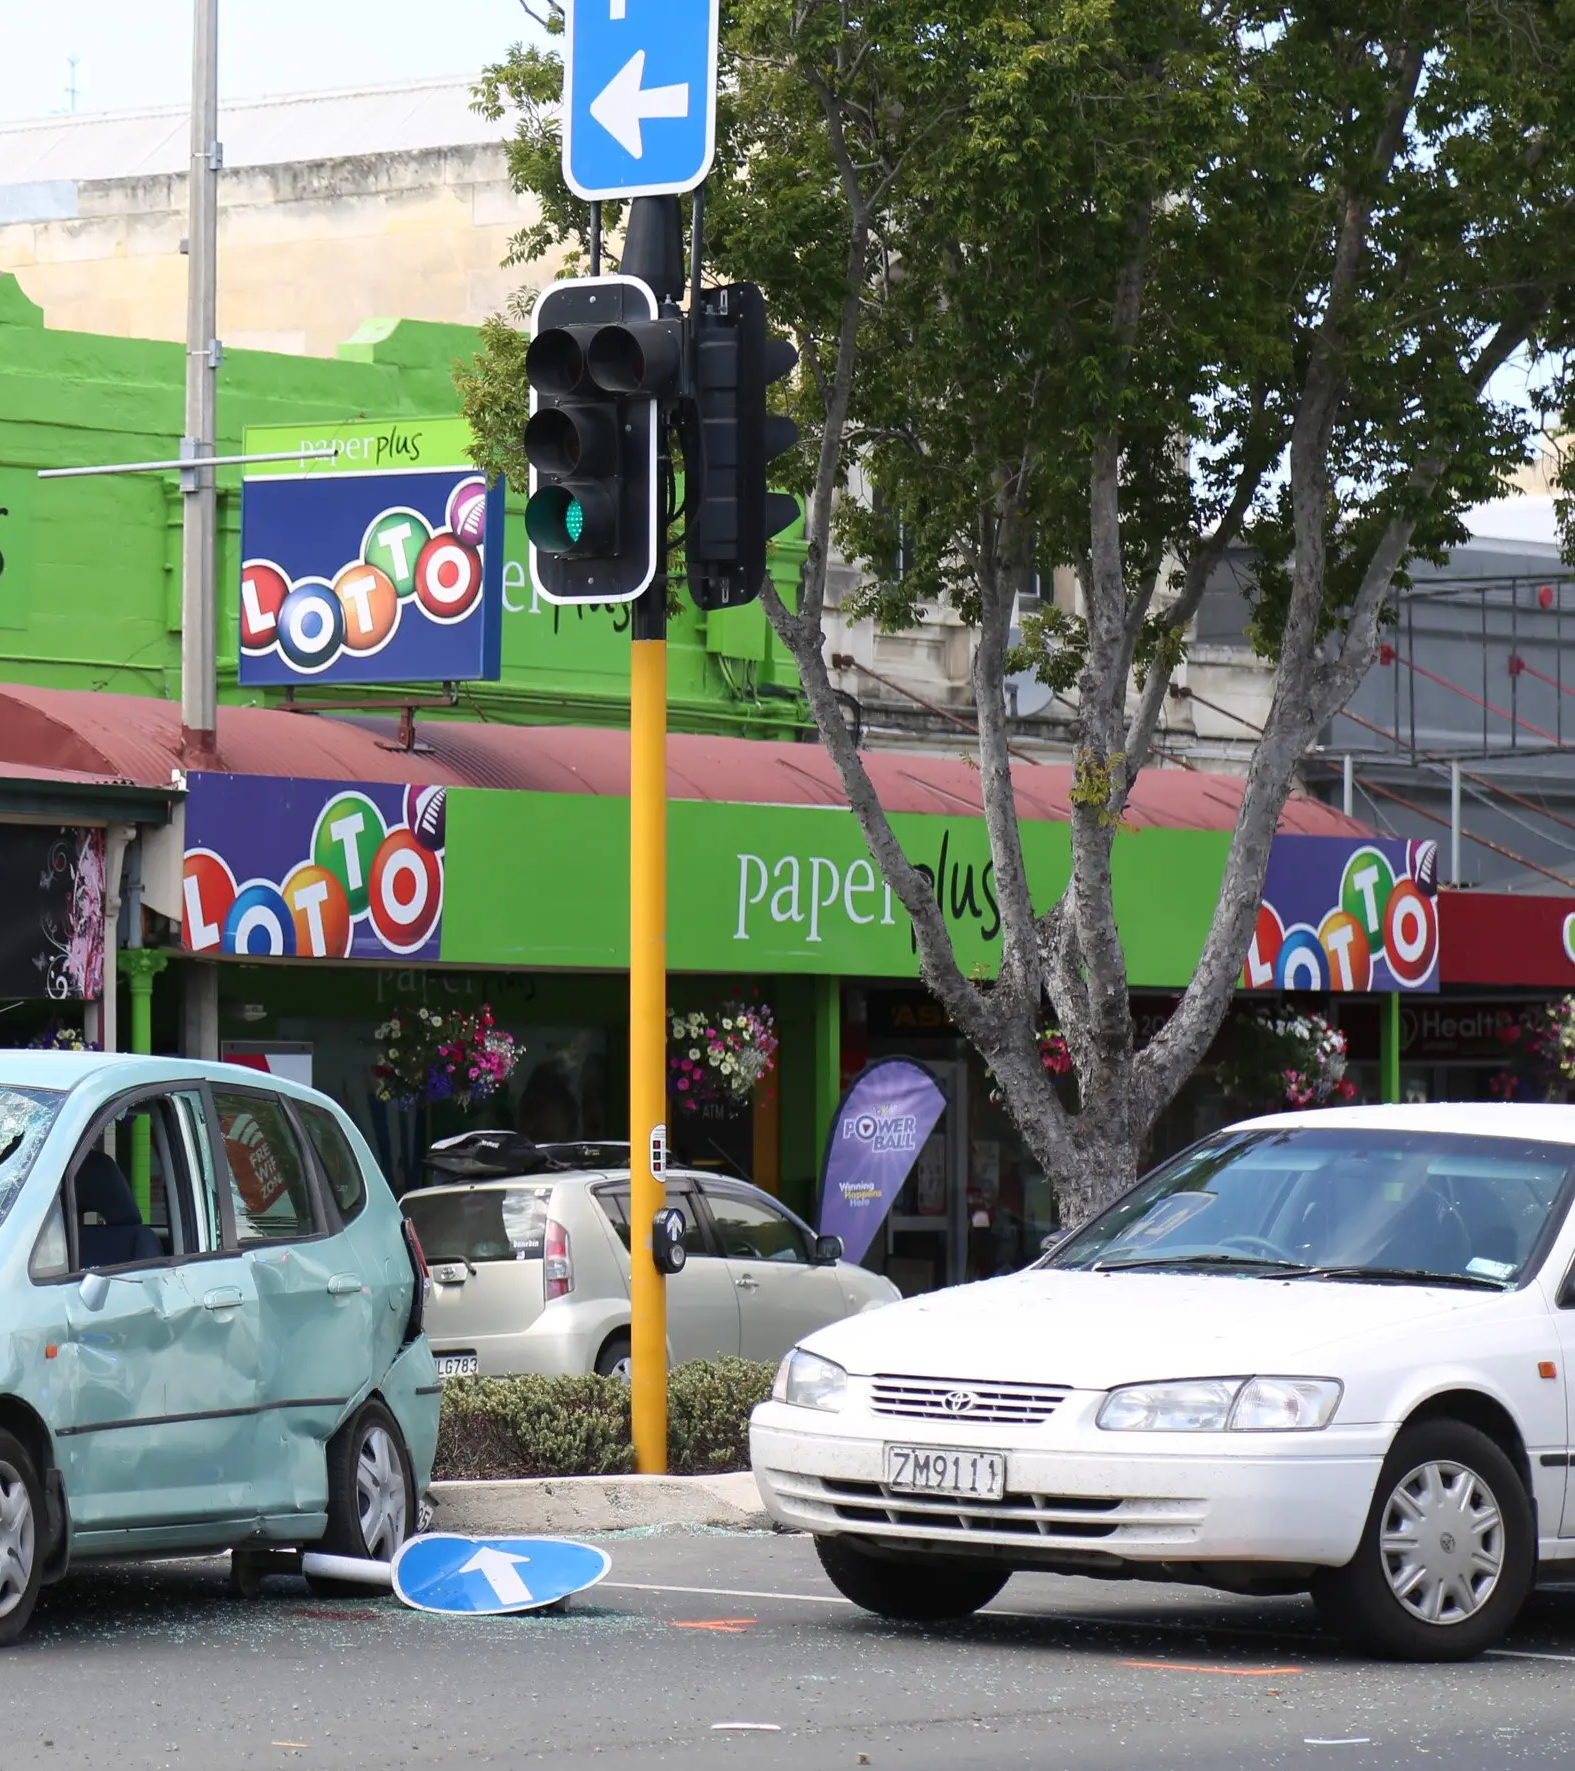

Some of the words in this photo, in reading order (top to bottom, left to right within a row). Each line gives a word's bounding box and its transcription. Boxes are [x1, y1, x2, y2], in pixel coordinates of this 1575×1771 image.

[242, 522, 471, 654] LOTTO
[183, 812, 428, 957] LOTTO
[1248, 864, 1427, 991] LOTTO
[702, 1104, 724, 1121] ATM
[843, 1114, 916, 1141] POWER
[872, 1132, 916, 1153] BALL
[839, 1180, 875, 1192] Winning
[435, 1358, 478, 1375] LG783
[892, 1452, 999, 1493] ZM9111
